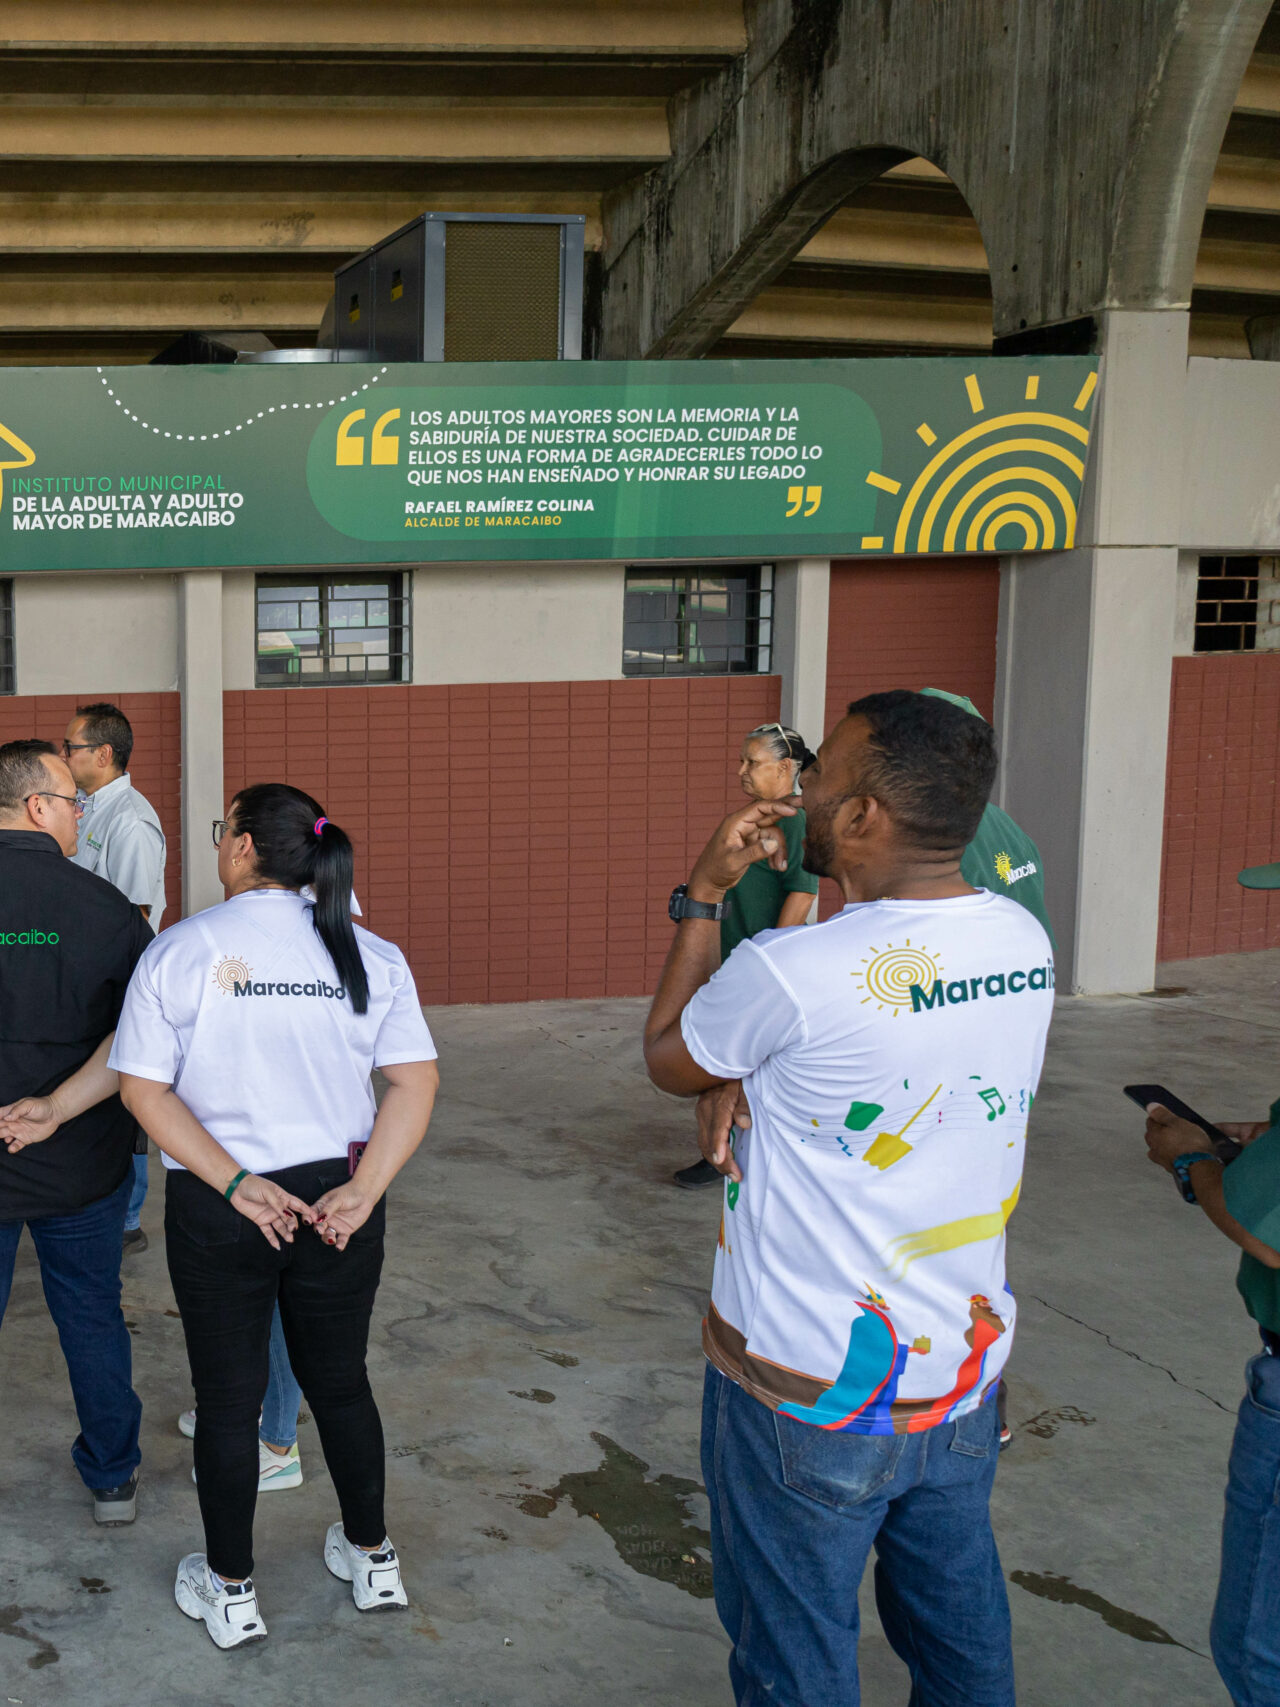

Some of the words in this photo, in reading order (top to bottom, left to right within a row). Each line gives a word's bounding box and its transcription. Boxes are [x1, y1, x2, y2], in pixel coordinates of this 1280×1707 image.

[410, 411, 442, 426] LOS
[447, 410, 525, 425] ADULTOS
[530, 410, 612, 424] MAYORES
[617, 409, 653, 423] SON
[657, 409, 677, 423] LA
[681, 408, 760, 422] MEMORIA
[765, 408, 776, 421] Y
[780, 407, 799, 421] LA
[410, 426, 499, 445] SABIDURÍA
[505, 430, 526, 444] DE
[531, 429, 608, 444] NUESTRA
[612, 428, 703, 442] SOCIEDAD.
[708, 427, 771, 442] CUIDAR
[775, 427, 796, 440] DE
[408, 450, 457, 465] ELLOS
[462, 450, 481, 464] ES
[486, 450, 522, 464] UNA
[527, 449, 587, 463] FORMA
[592, 449, 612, 462] DE
[617, 447, 745, 462] AGRADECERLES
[750, 446, 797, 460] TODO
[801, 446, 822, 460] LO
[13, 477, 112, 493] INSTITUTO
[120, 475, 225, 491] MUNICIPAL
[407, 470, 441, 486] QUE
[446, 470, 483, 484] NOS
[487, 470, 524, 483] HAN
[528, 466, 619, 482] ENSEÑADO
[624, 468, 634, 481] Y
[638, 467, 709, 481] HONRAR
[714, 467, 735, 480] SU
[740, 465, 805, 480] LEGADO
[13, 496, 36, 512] DE
[42, 496, 65, 512] LA
[69, 495, 146, 512] ADULTA
[150, 494, 165, 510] Y
[167, 493, 244, 510] ADULTO
[405, 501, 461, 514] RAFAEL
[466, 497, 533, 513] RAMÍREZ
[537, 500, 594, 511] COLINA
[13, 514, 84, 530] MAYOR
[89, 513, 112, 529] DE
[117, 511, 235, 528] MARACAIBO
[404, 517, 460, 528] ALCALDE
[465, 517, 480, 527] DE
[485, 516, 562, 526] MARACAIBO
[233, 979, 346, 1000] Maracaibo
[909, 958, 1055, 1013] Maracai
